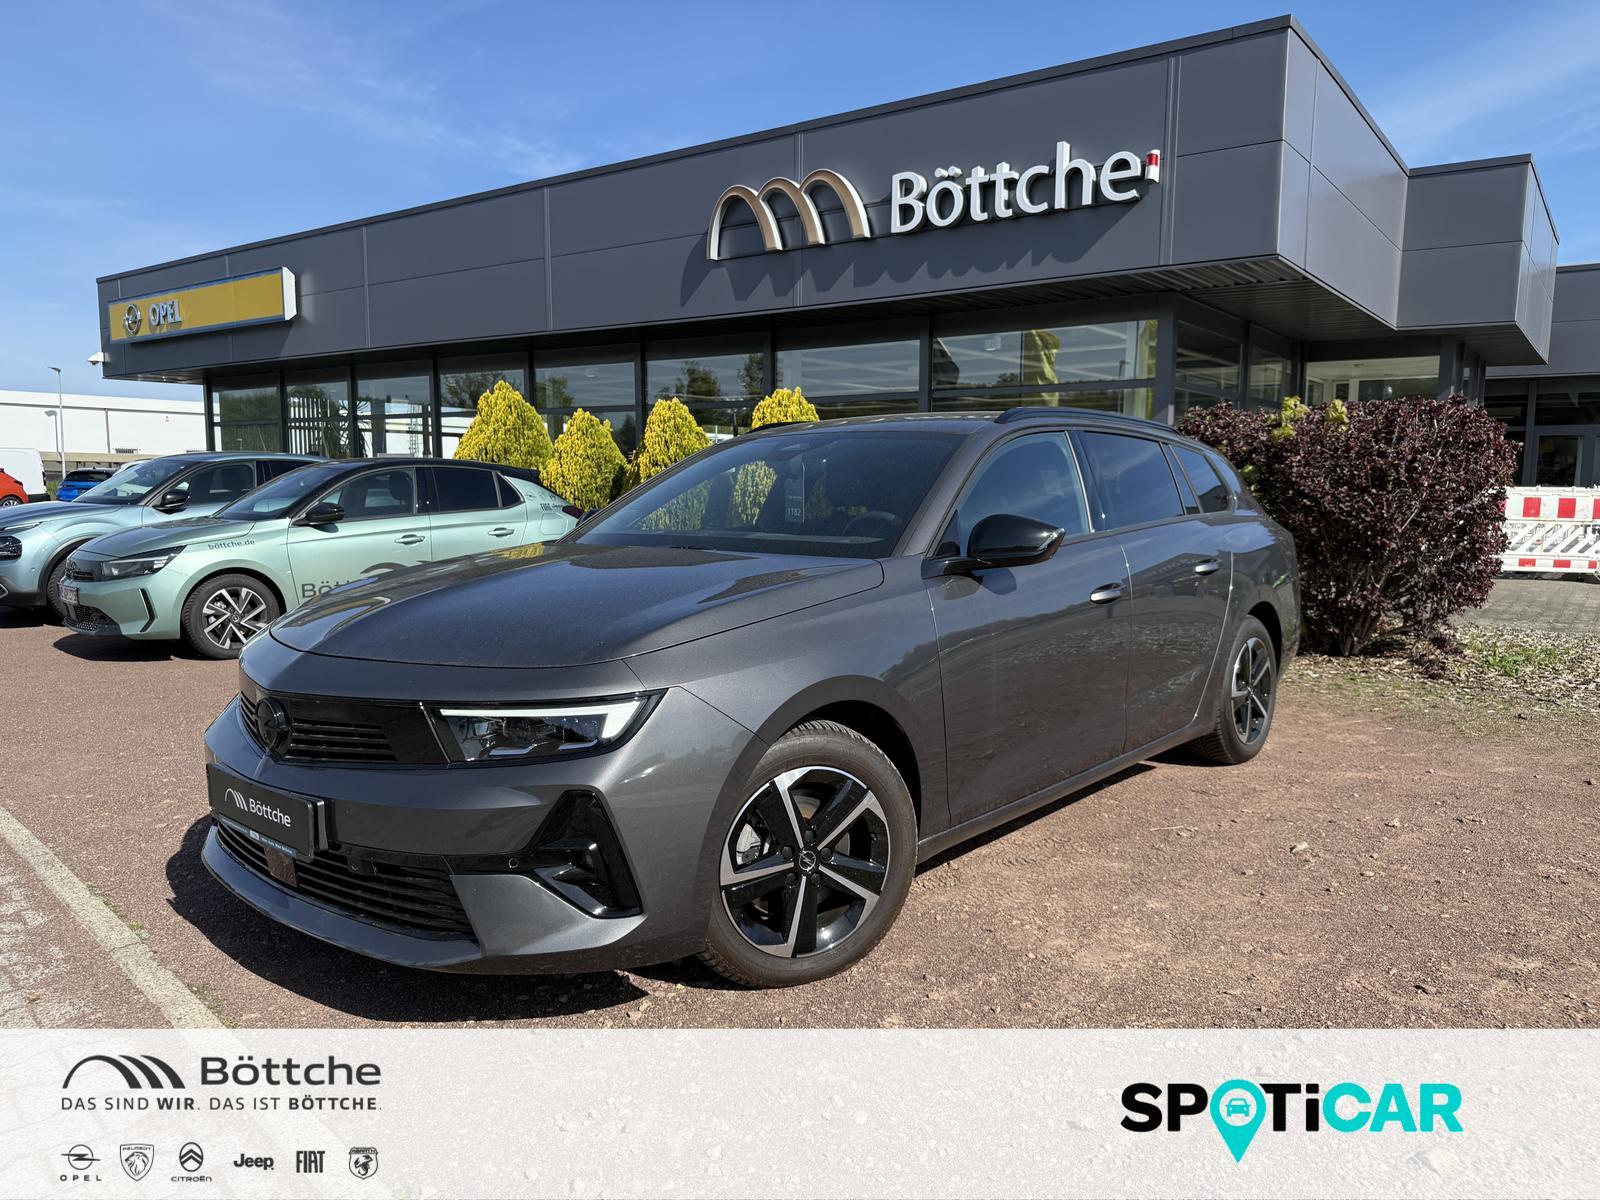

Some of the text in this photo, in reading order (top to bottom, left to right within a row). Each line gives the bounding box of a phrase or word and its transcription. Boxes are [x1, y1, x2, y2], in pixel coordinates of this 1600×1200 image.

[889, 141, 1141, 235] Böttche
[149, 299, 183, 326] OPEL
[207, 539, 255, 550] böttche.de
[248, 797, 291, 827] Böttche
